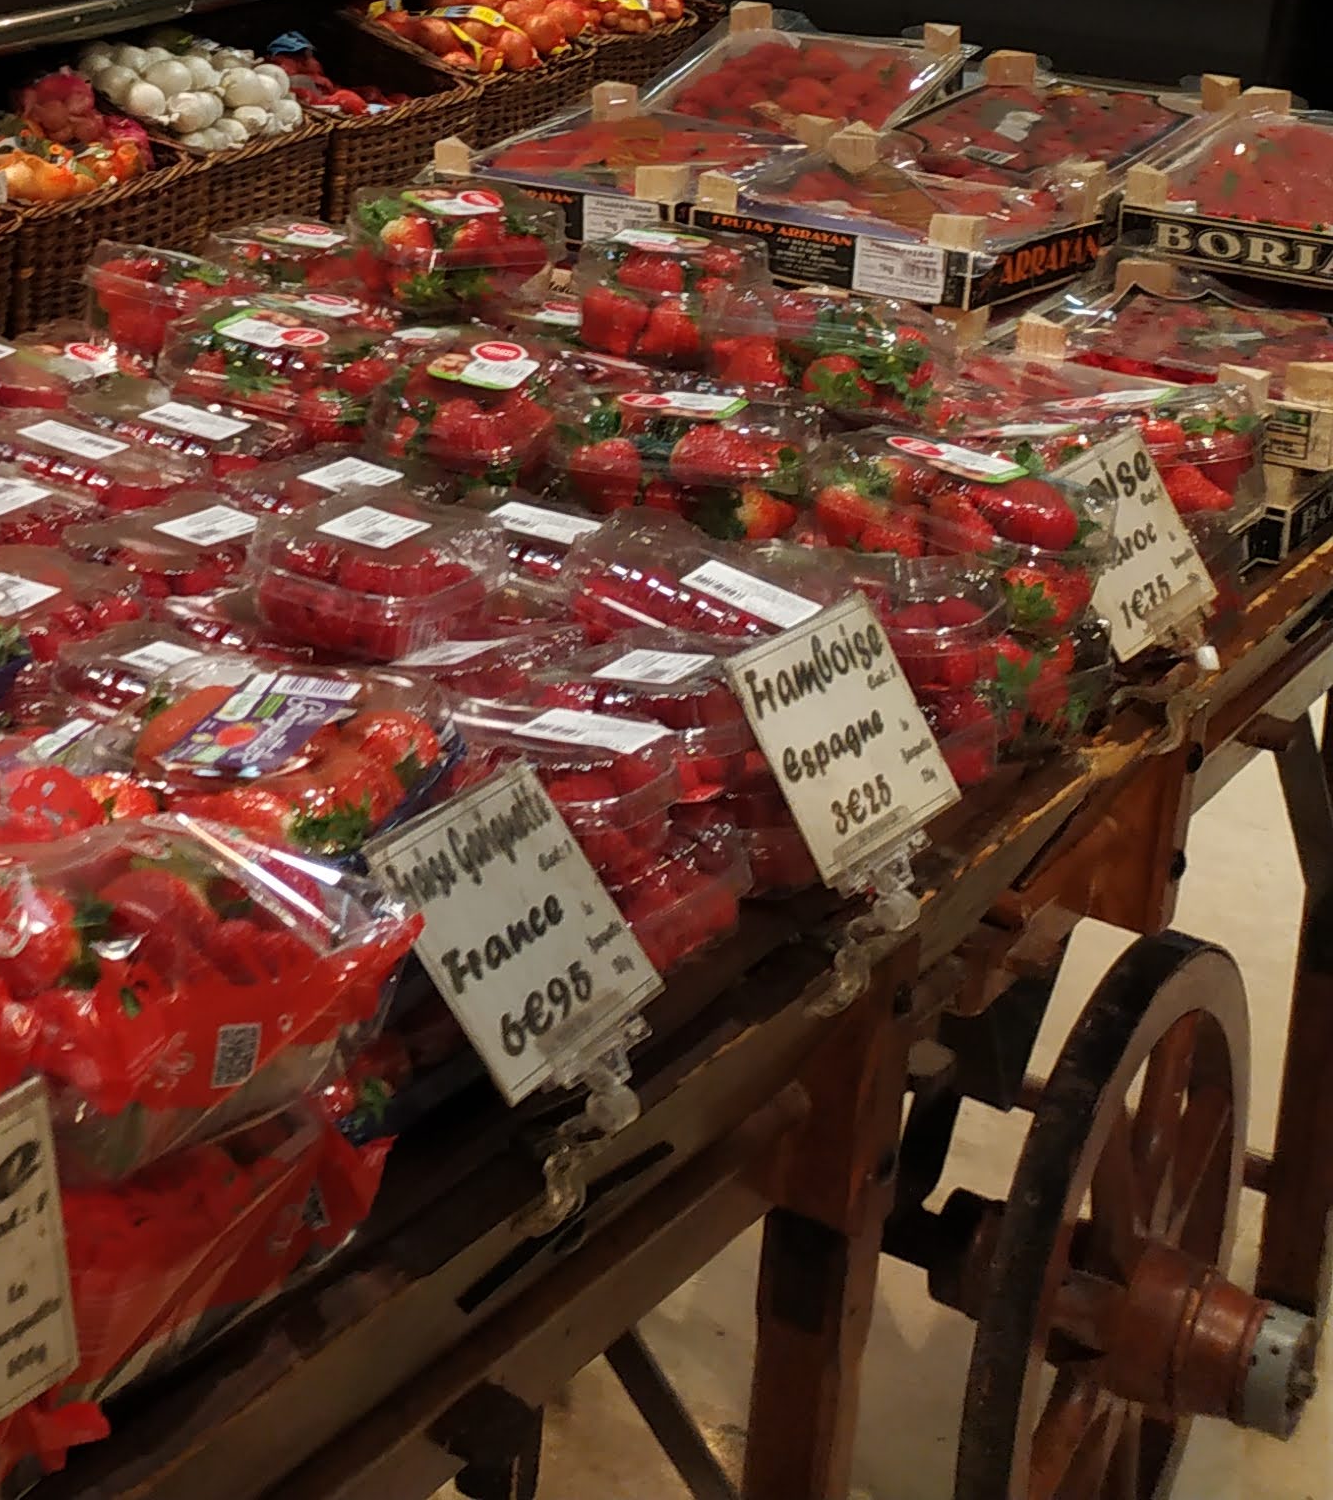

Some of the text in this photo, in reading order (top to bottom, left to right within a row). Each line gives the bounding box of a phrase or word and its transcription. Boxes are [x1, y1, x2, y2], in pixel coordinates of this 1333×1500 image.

[710, 213, 775, 235] FRUTAS
[743, 623, 884, 720] Framboise
[829, 773, 894, 836] 3€25
[440, 894, 565, 996] France
[499, 960, 594, 1058] 6€95
